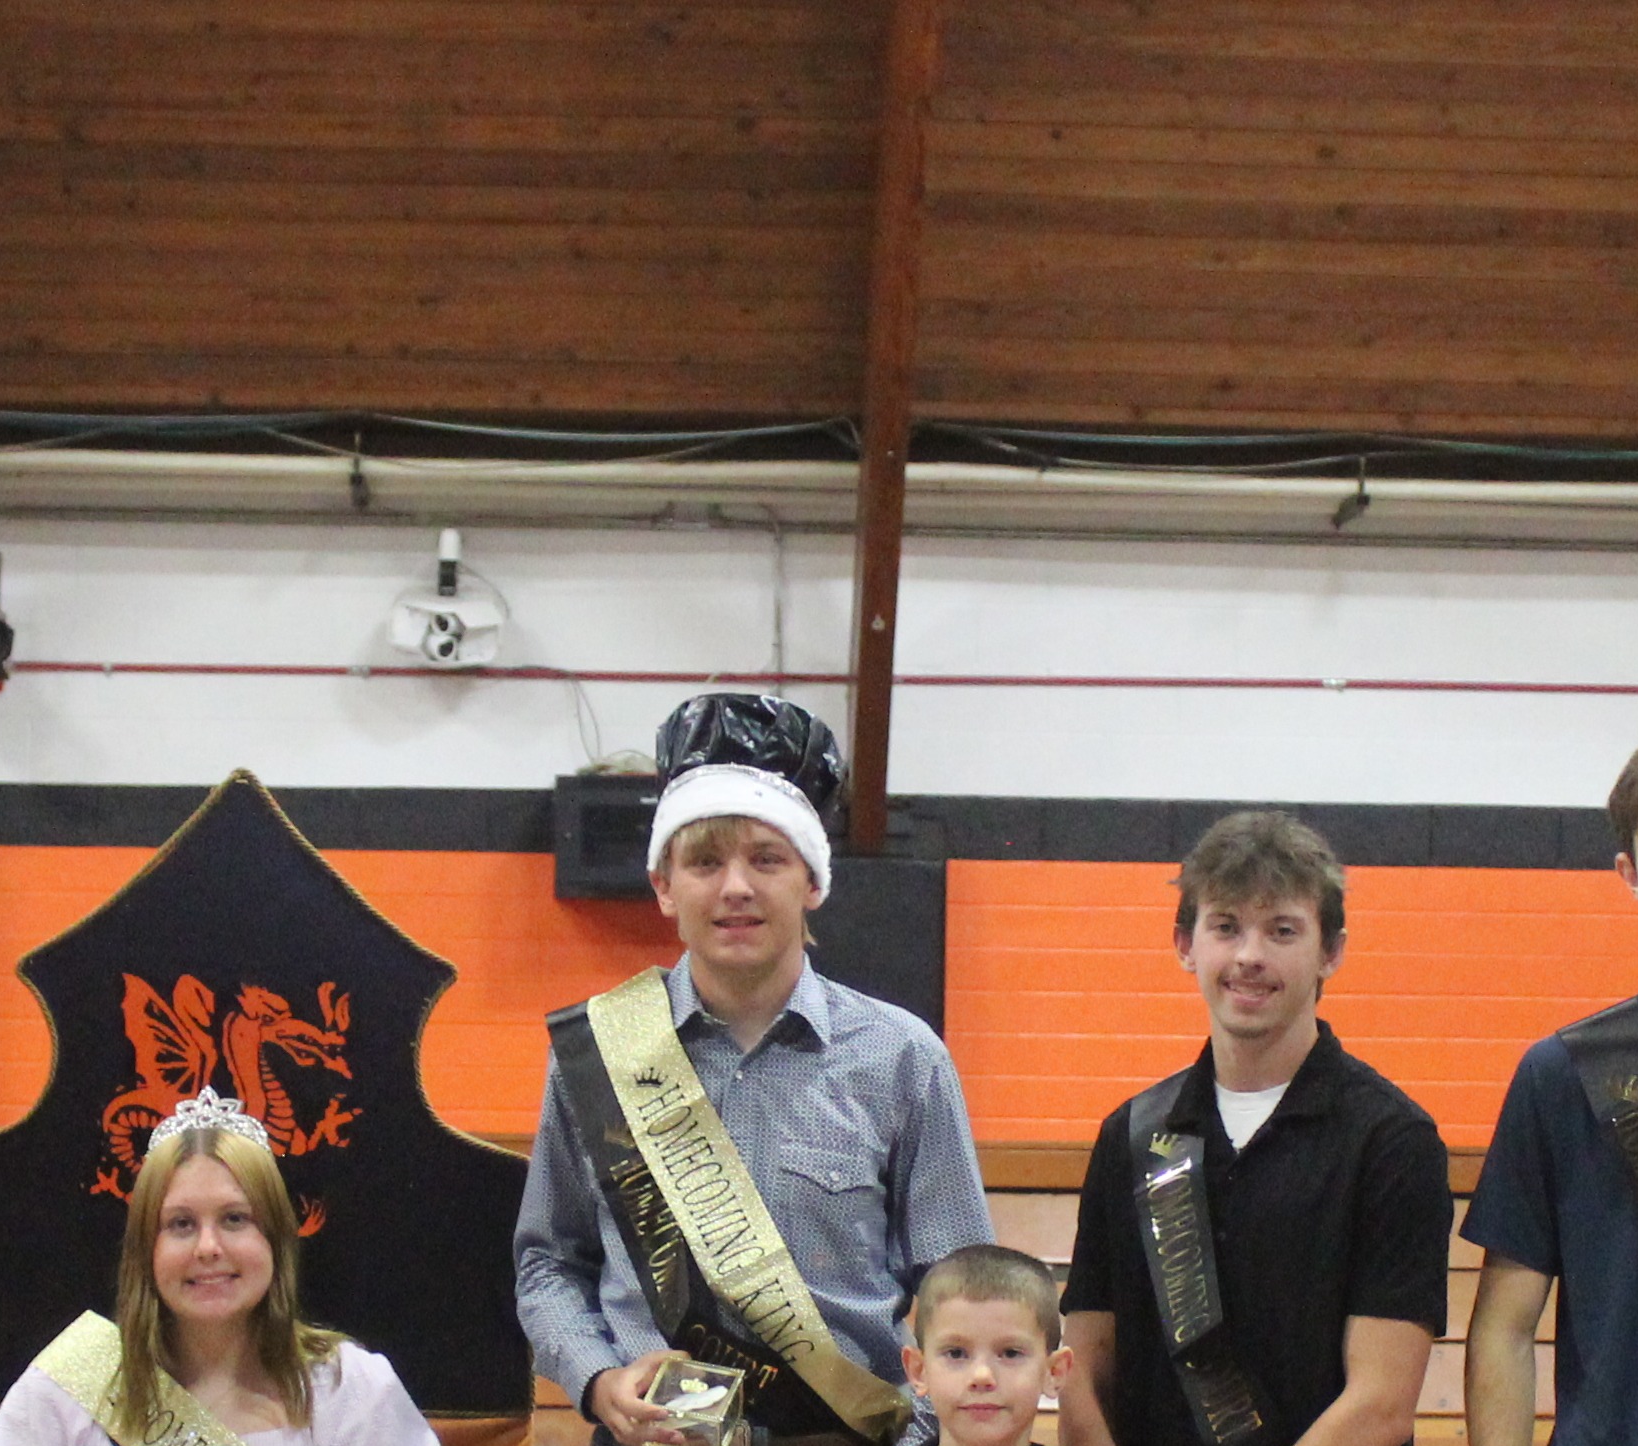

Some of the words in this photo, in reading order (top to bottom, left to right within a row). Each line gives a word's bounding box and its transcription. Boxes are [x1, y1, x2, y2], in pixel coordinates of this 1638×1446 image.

[638, 1081, 766, 1276] HOMECOMING
[731, 1278, 816, 1365] KING
[1145, 1157, 1210, 1344] HOMECOMING
